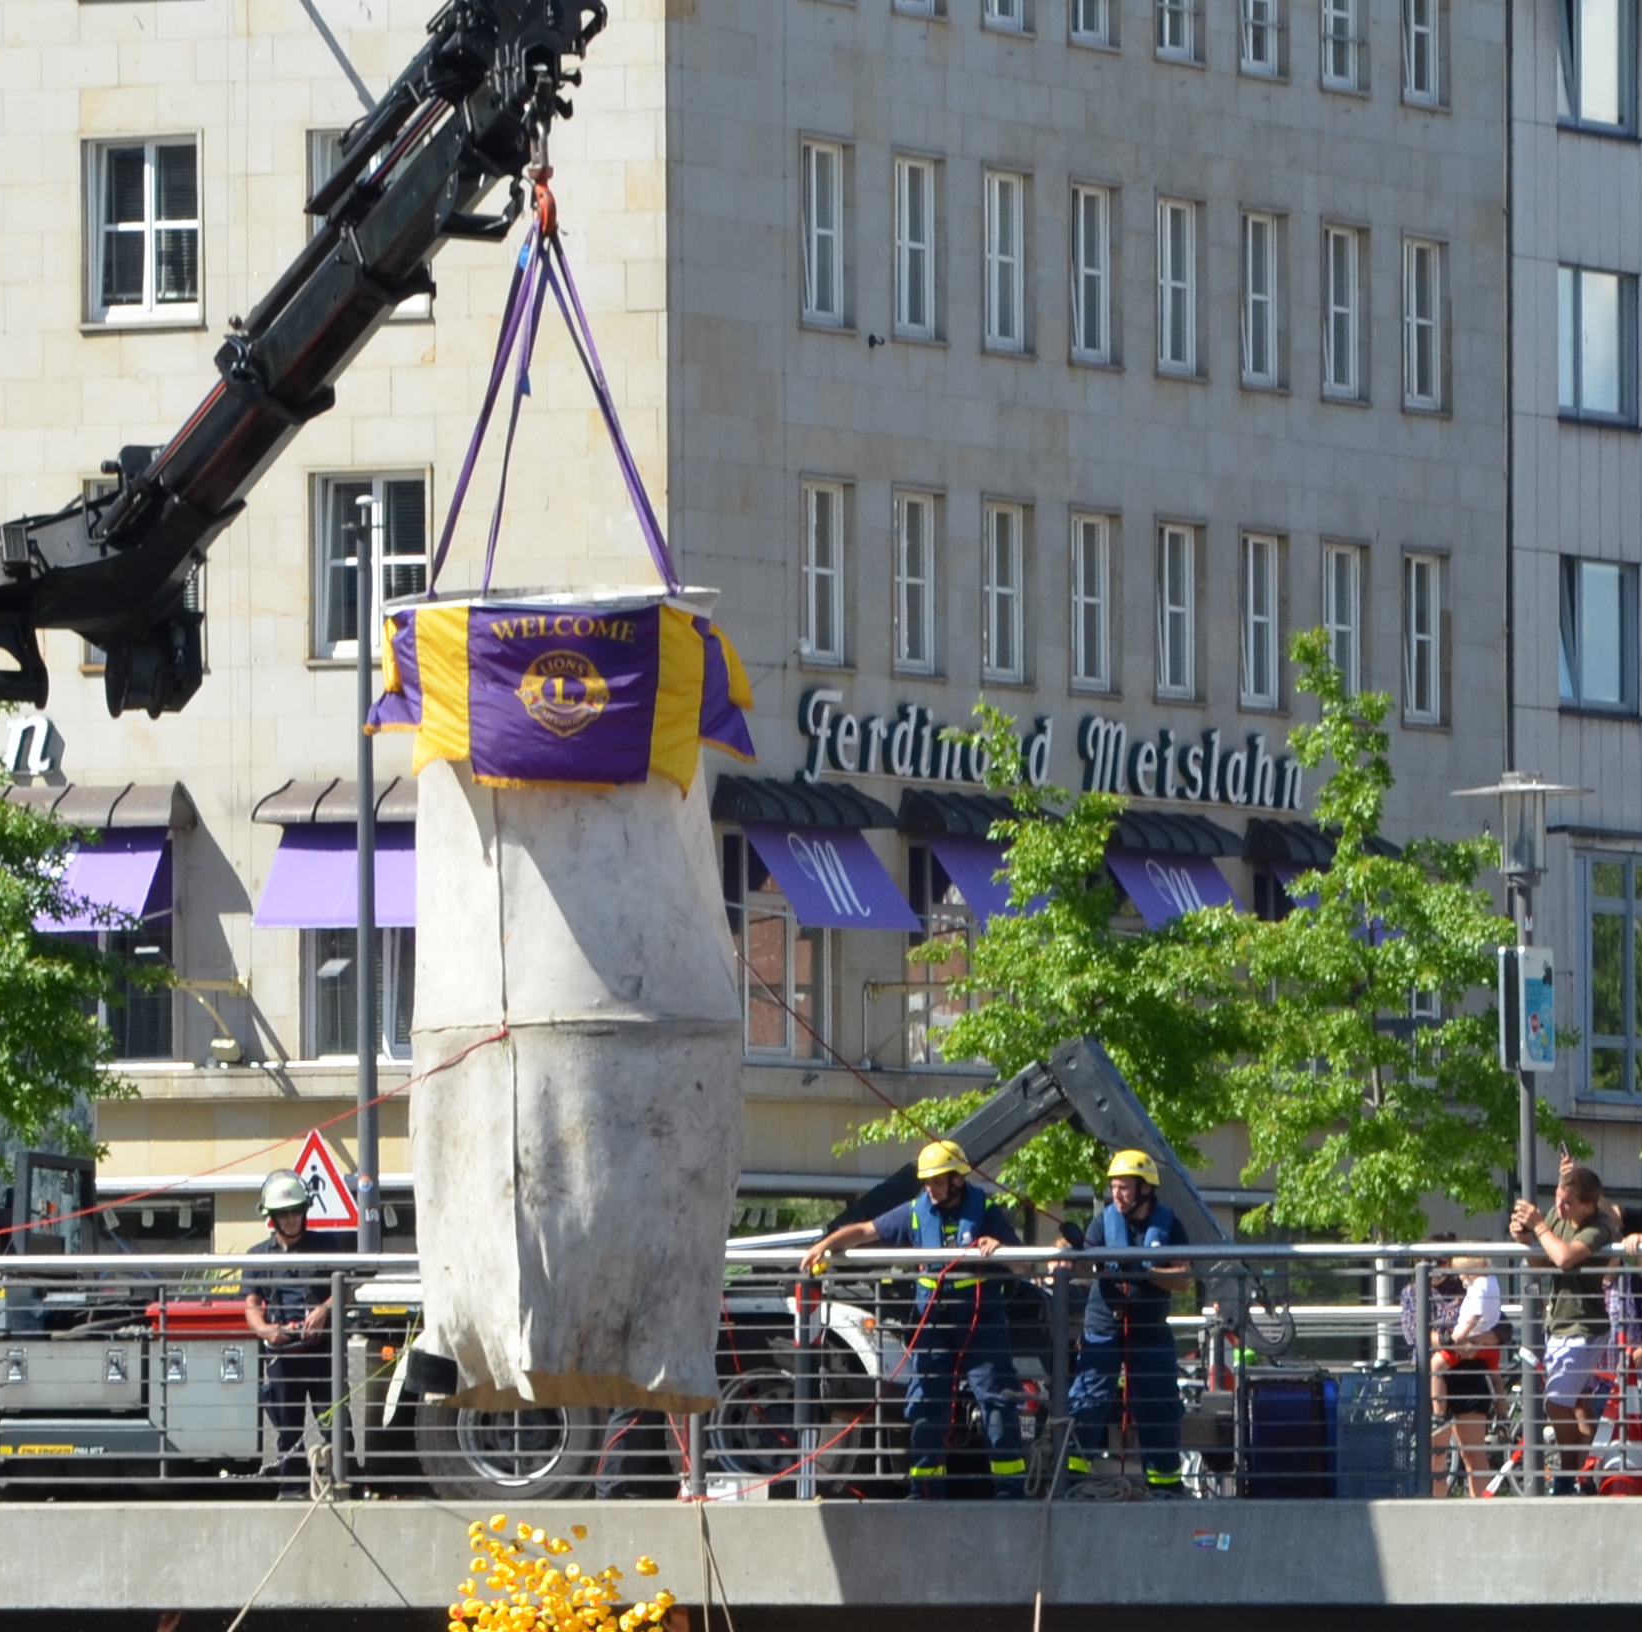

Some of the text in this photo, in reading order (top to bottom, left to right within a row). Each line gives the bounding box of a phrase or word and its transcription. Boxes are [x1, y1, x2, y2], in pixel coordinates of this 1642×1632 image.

[490, 614, 637, 643] WELCOME
[539, 658, 586, 676] LIONS
[552, 677, 575, 705] L
[1084, 715, 1304, 811] Meislahn
